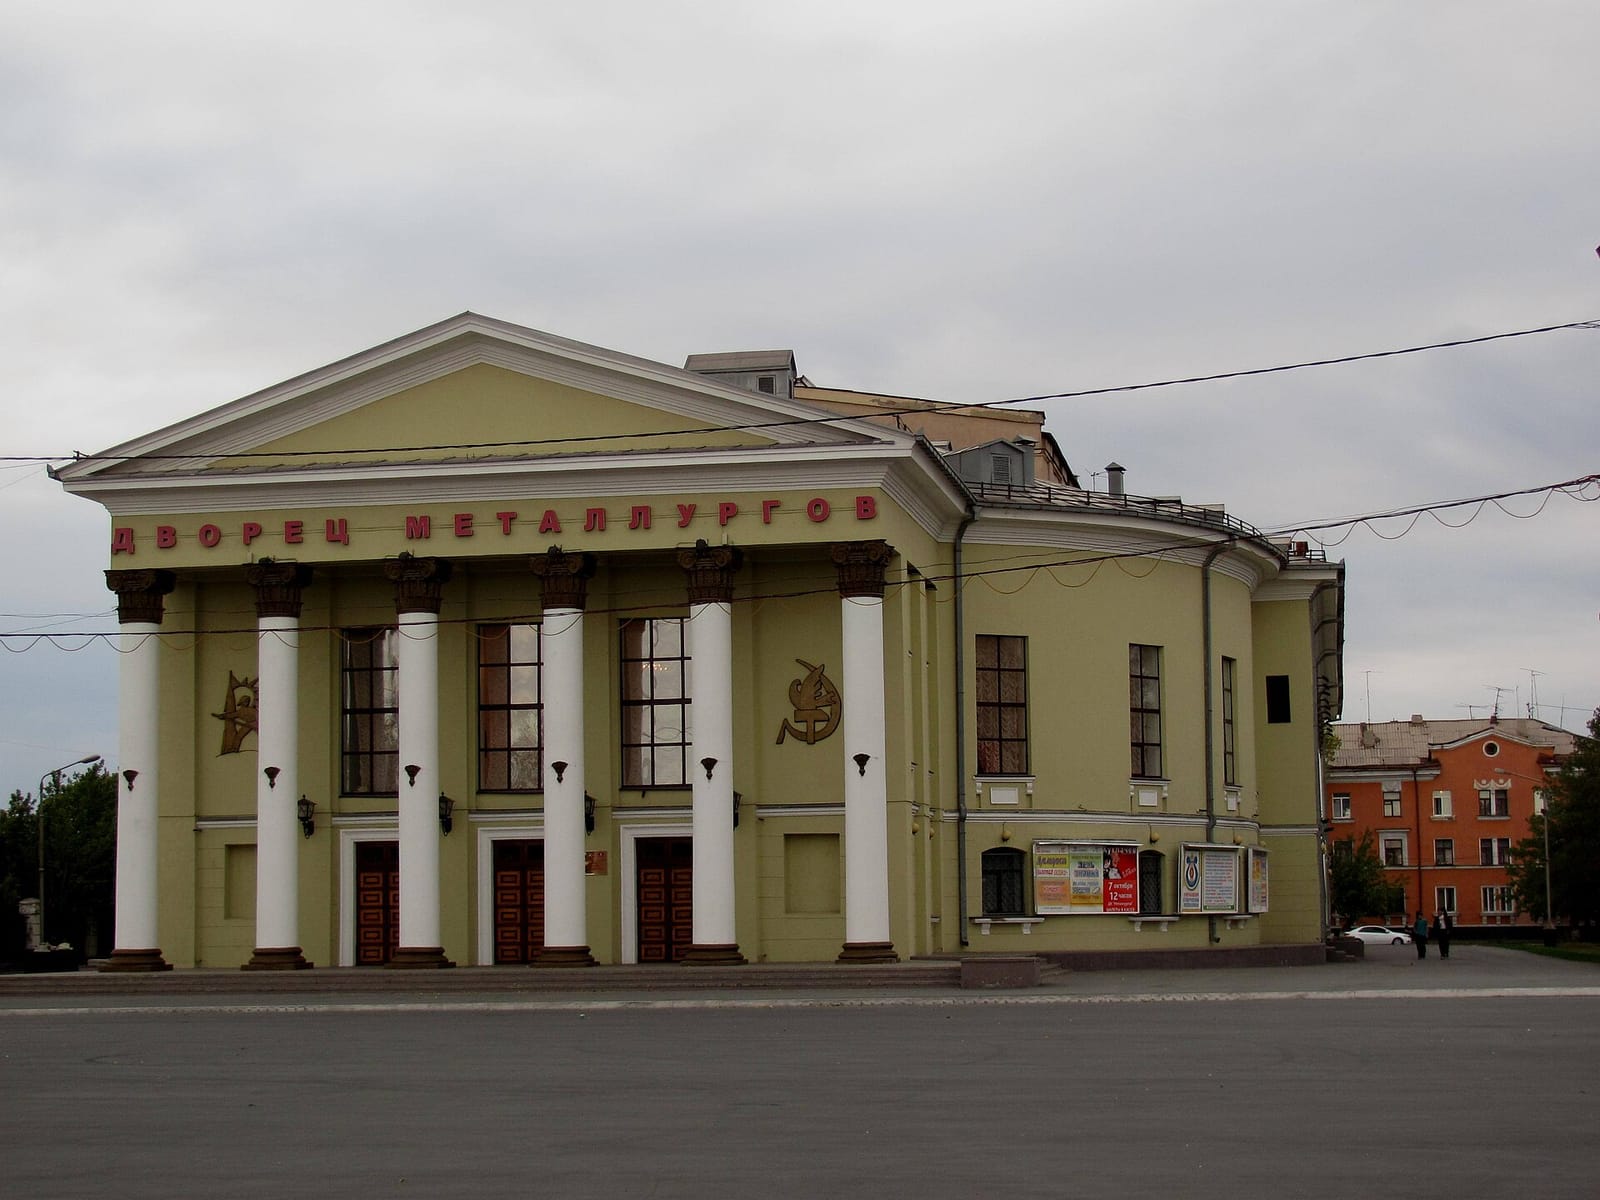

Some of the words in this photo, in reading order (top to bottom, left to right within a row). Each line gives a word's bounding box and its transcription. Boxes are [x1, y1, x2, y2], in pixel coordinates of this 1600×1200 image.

[112, 517, 349, 555] ДВОРЕЦ
[405, 495, 877, 539] МЕТАЛЛУРГОВ
[1108, 882, 1113, 891] 7
[1109, 892, 1118, 901] 12
